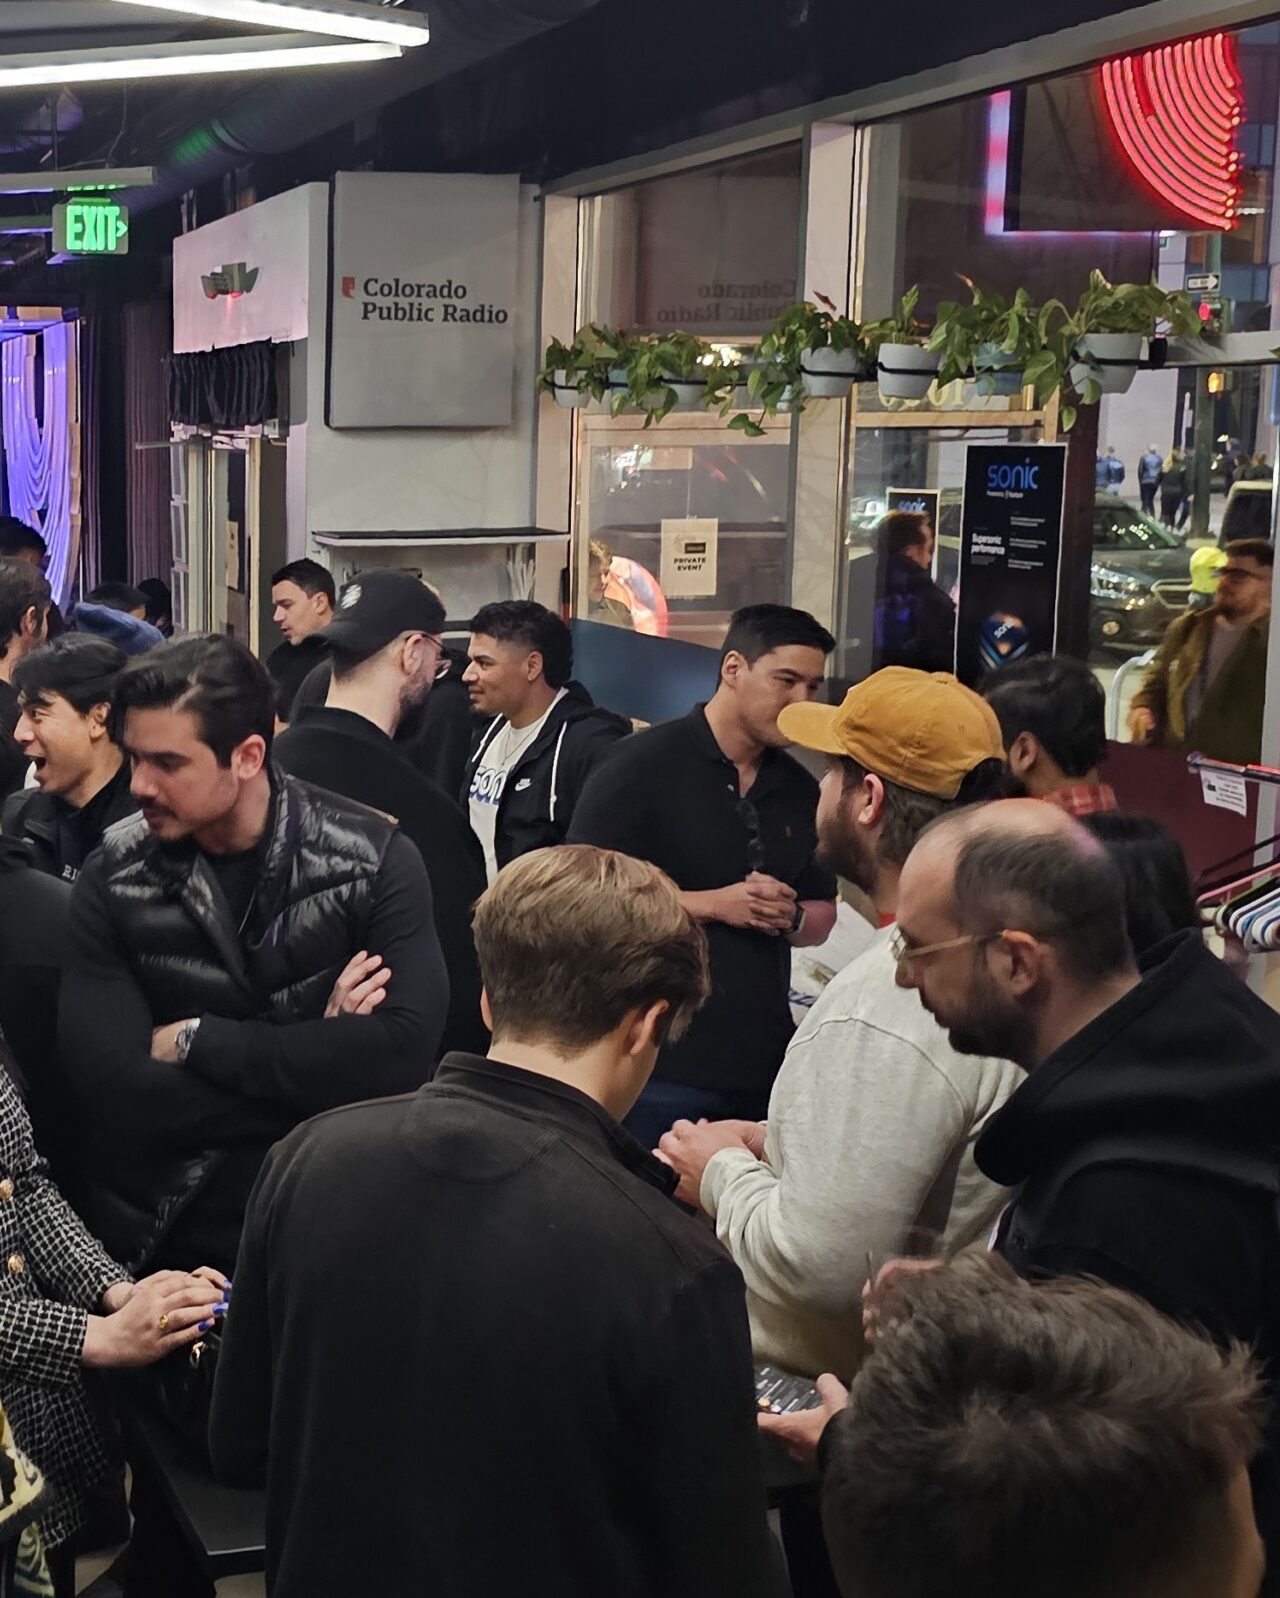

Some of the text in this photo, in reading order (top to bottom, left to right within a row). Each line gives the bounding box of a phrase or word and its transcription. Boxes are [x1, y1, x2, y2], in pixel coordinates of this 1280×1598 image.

[66, 205, 120, 251] EXIT
[363, 277, 468, 299] Colorado
[361, 301, 508, 324] Public Radio
[987, 457, 1039, 490] sonic
